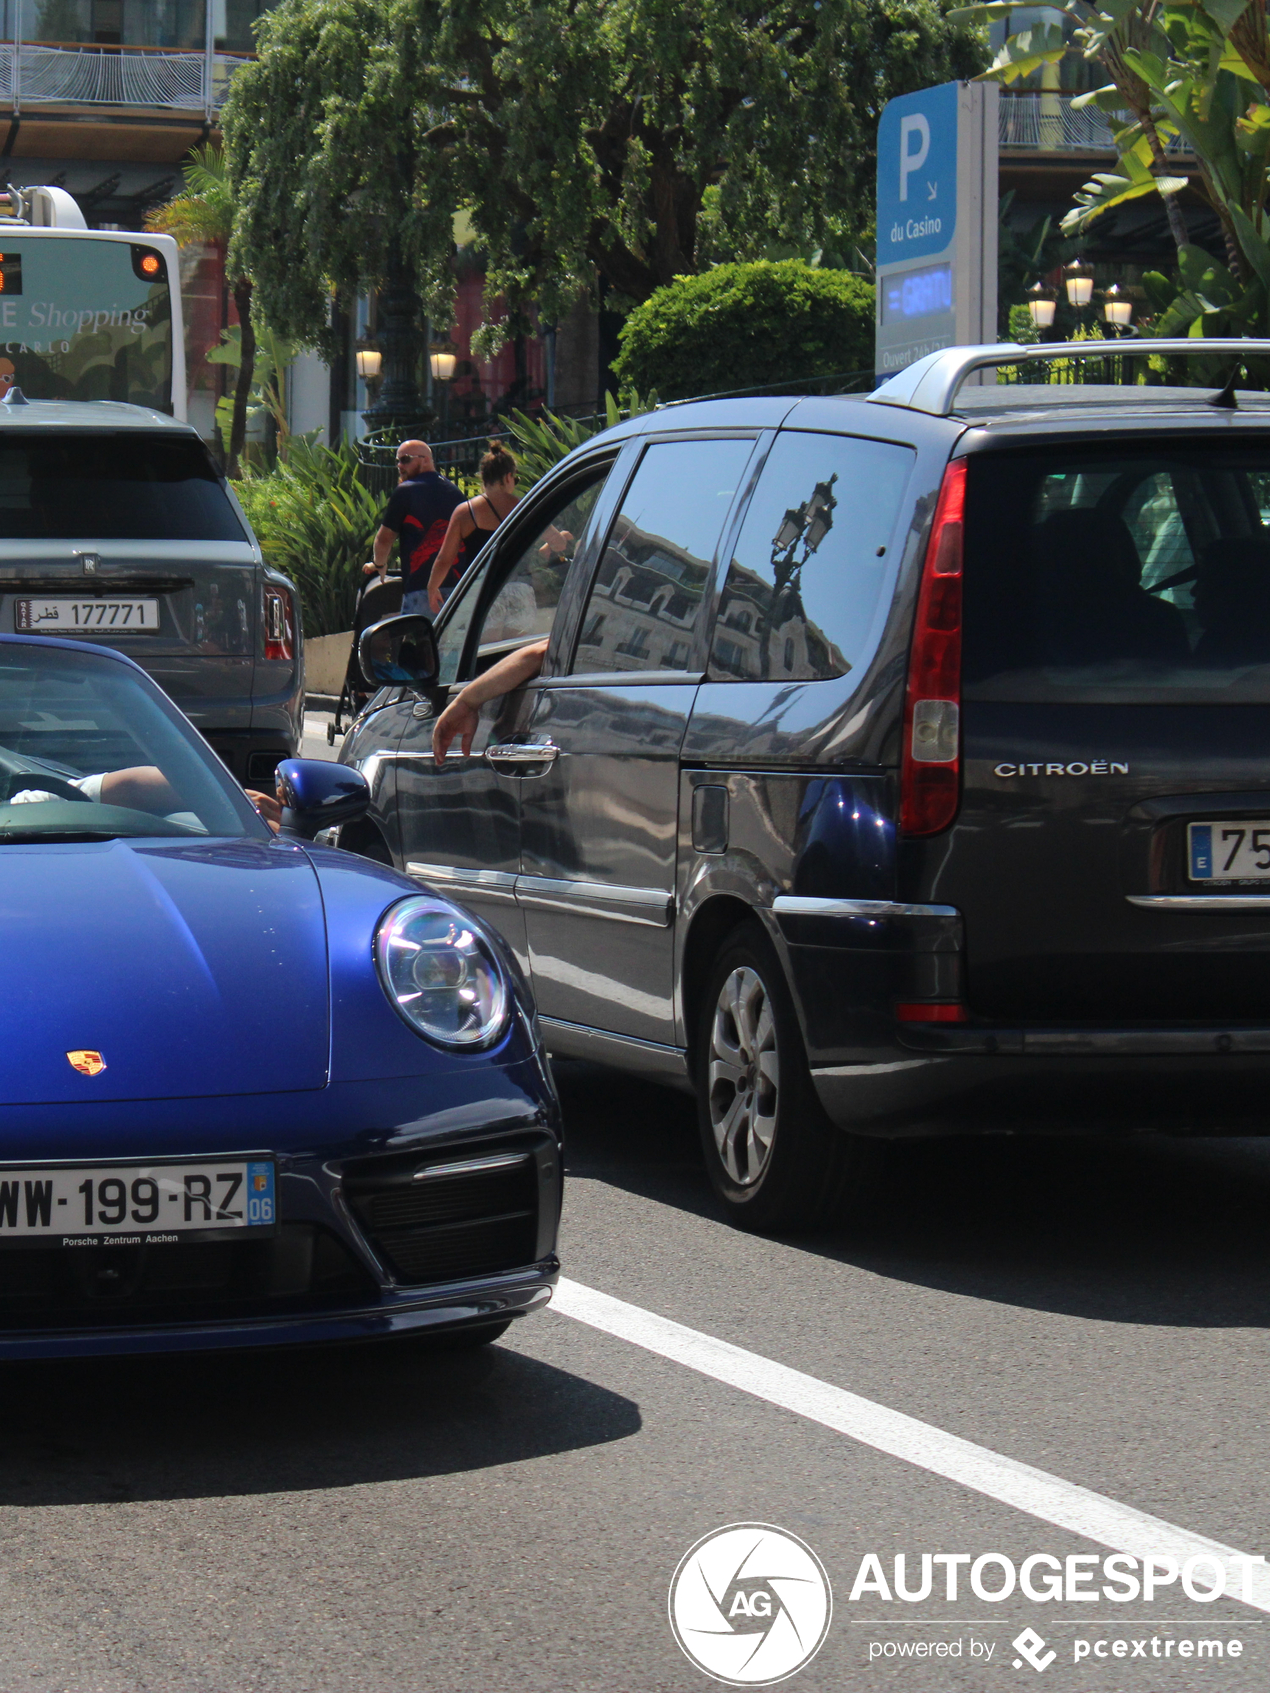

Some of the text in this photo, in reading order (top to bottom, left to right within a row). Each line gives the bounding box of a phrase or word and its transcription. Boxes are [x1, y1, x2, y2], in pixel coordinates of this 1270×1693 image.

[899, 112, 930, 202] P
[890, 215, 942, 243] du Casino
[28, 301, 151, 335] Shopping
[33, 606, 59, 623] قطر
[71, 603, 145, 625] 177771
[994, 758, 1129, 777] CITROËN
[1221, 828, 1270, 871] 75
[1197, 856, 1207, 869] E
[249, 1197, 272, 1221] 06
[62, 1234, 179, 1246] Porsche Zentrum Aachen
